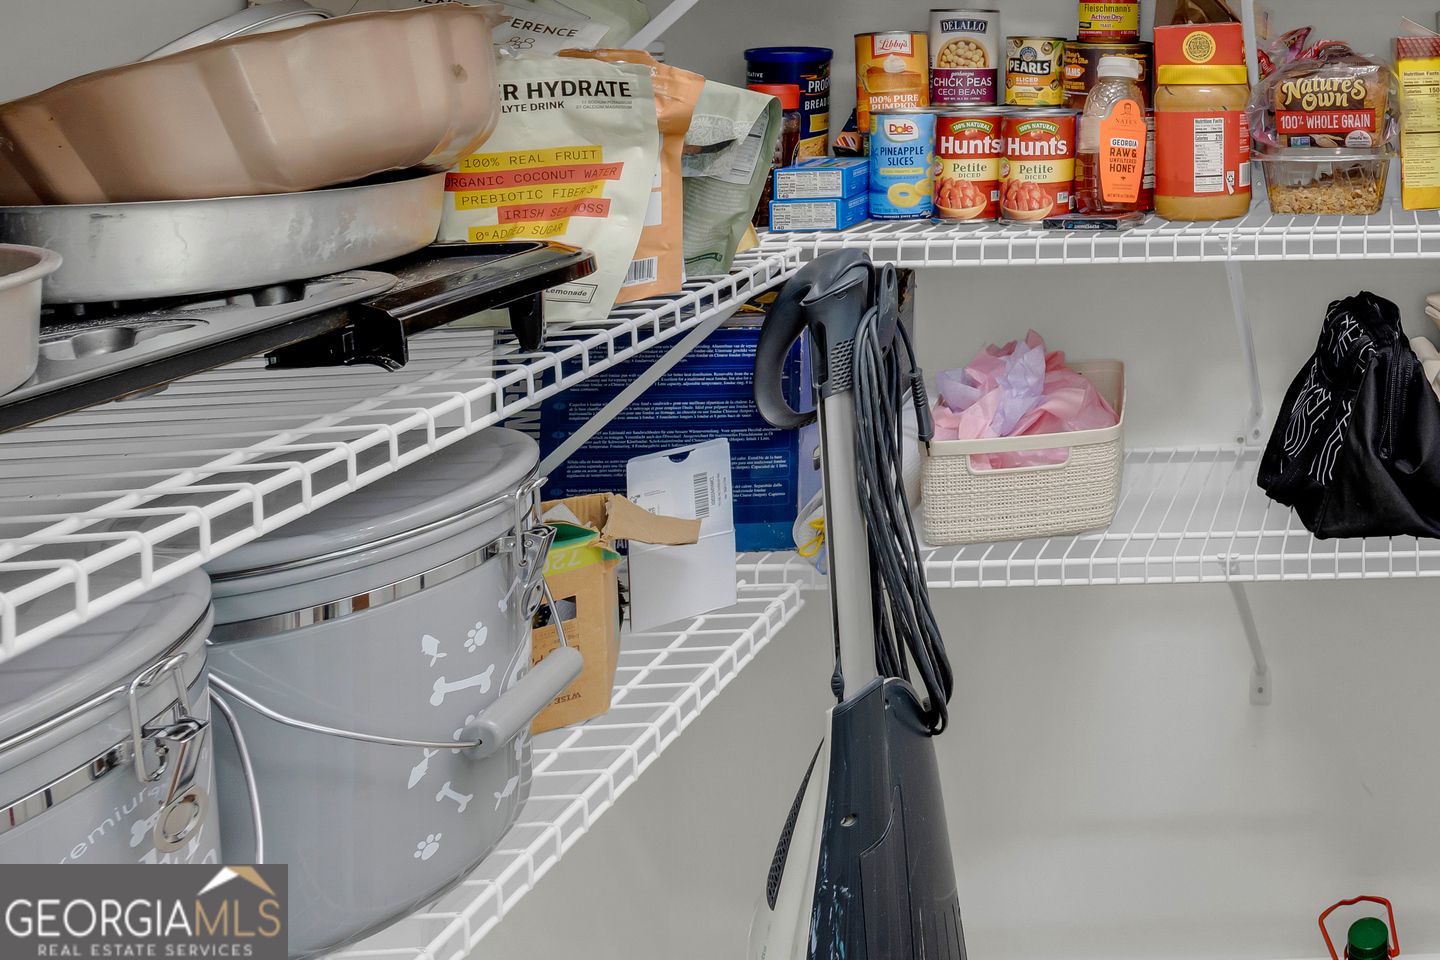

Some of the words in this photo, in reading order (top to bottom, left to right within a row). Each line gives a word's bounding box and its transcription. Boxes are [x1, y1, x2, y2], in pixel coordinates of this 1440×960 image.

[1084, 4, 1132, 13] Fleischmann's
[508, 18, 579, 38] ERENCE
[942, 21, 985, 31] DELALLO
[880, 37, 908, 50] Libby's
[1009, 60, 1050, 74] PEARLS
[934, 77, 963, 87] CHICK
[966, 77, 992, 87] PEAS
[527, 80, 632, 100] HYDRATE
[938, 88, 955, 96] CECI
[958, 88, 987, 96] BEANS
[1282, 75, 1367, 106] Nature's
[869, 96, 891, 104] 100%
[894, 94, 918, 102] PURE
[1302, 92, 1349, 112] Own
[500, 104, 527, 114] LYTE
[530, 100, 565, 111] DRINK
[804, 99, 826, 111] BREAD
[871, 102, 917, 110] PUMPKIN
[952, 122, 965, 131] 100%
[965, 121, 990, 131] NATURAL
[1018, 123, 1032, 131] 100%
[1032, 122, 1057, 132] NATURAL
[1280, 116, 1304, 130] 100%
[1306, 115, 1339, 129] WHOLE
[1341, 113, 1371, 128] GRAIN
[889, 124, 913, 134] Dole
[1112, 139, 1137, 147] GEORGIA
[879, 146, 924, 157] PINEAPPLE
[1109, 148, 1129, 157] RAW
[1131, 149, 1137, 158] &
[464, 157, 500, 169] 100%
[509, 154, 545, 166] REAL
[555, 149, 597, 161] FRUIT
[887, 156, 914, 166] SLICES
[952, 162, 988, 173] Petite
[1019, 164, 1054, 174] Petite
[1109, 164, 1136, 173] HONEY
[445, 175, 504, 188] ORGANIC
[514, 170, 575, 184] COCONUT
[584, 167, 617, 179] WATER
[461, 189, 543, 206] PREBIOTIC
[552, 186, 585, 198] FIBER
[504, 209, 545, 220] IRISH
[550, 206, 568, 217] SEA
[572, 202, 604, 213] MOSS
[491, 226, 525, 240] ADDED
[531, 222, 564, 236] SUGAR
[545, 287, 588, 297] Lemonade
[554, 691, 582, 704] WISE
